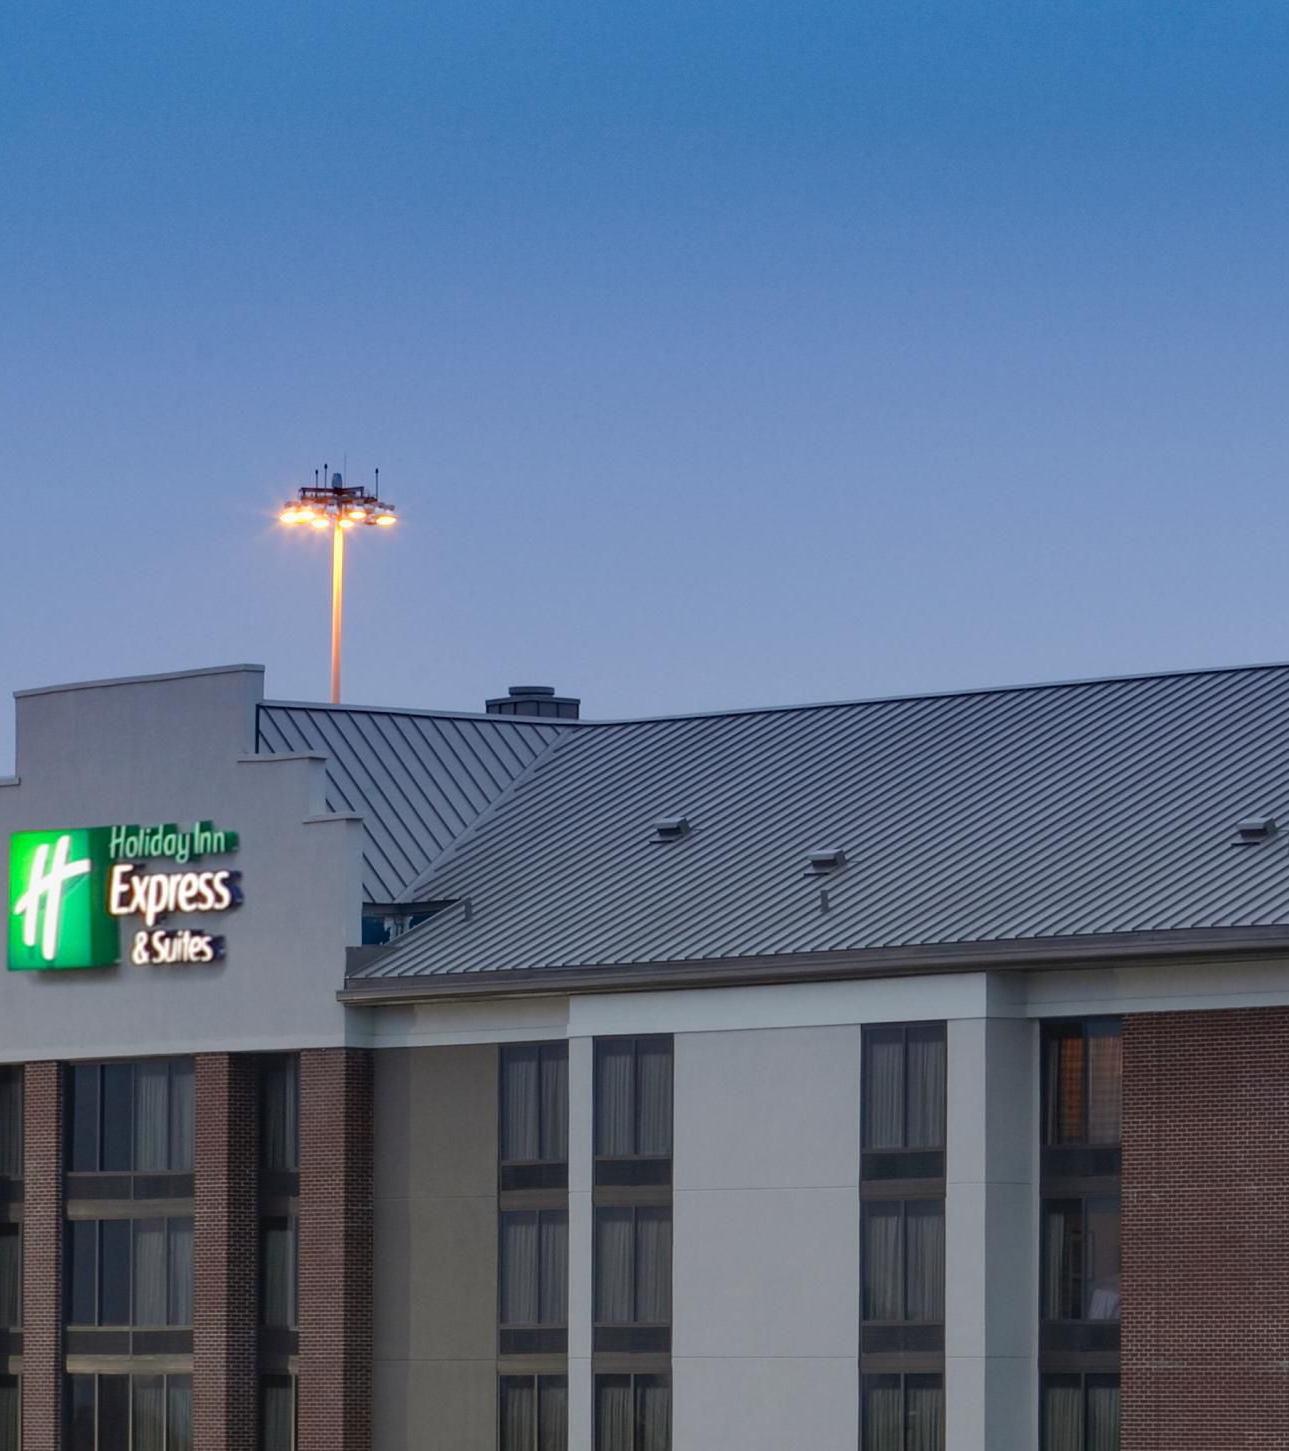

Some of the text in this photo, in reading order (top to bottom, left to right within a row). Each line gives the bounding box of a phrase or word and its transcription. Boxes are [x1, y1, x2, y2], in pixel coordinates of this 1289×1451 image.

[109, 820, 226, 864] Holiday Inn
[109, 864, 232, 927] Express
[131, 930, 214, 965] & Suites
